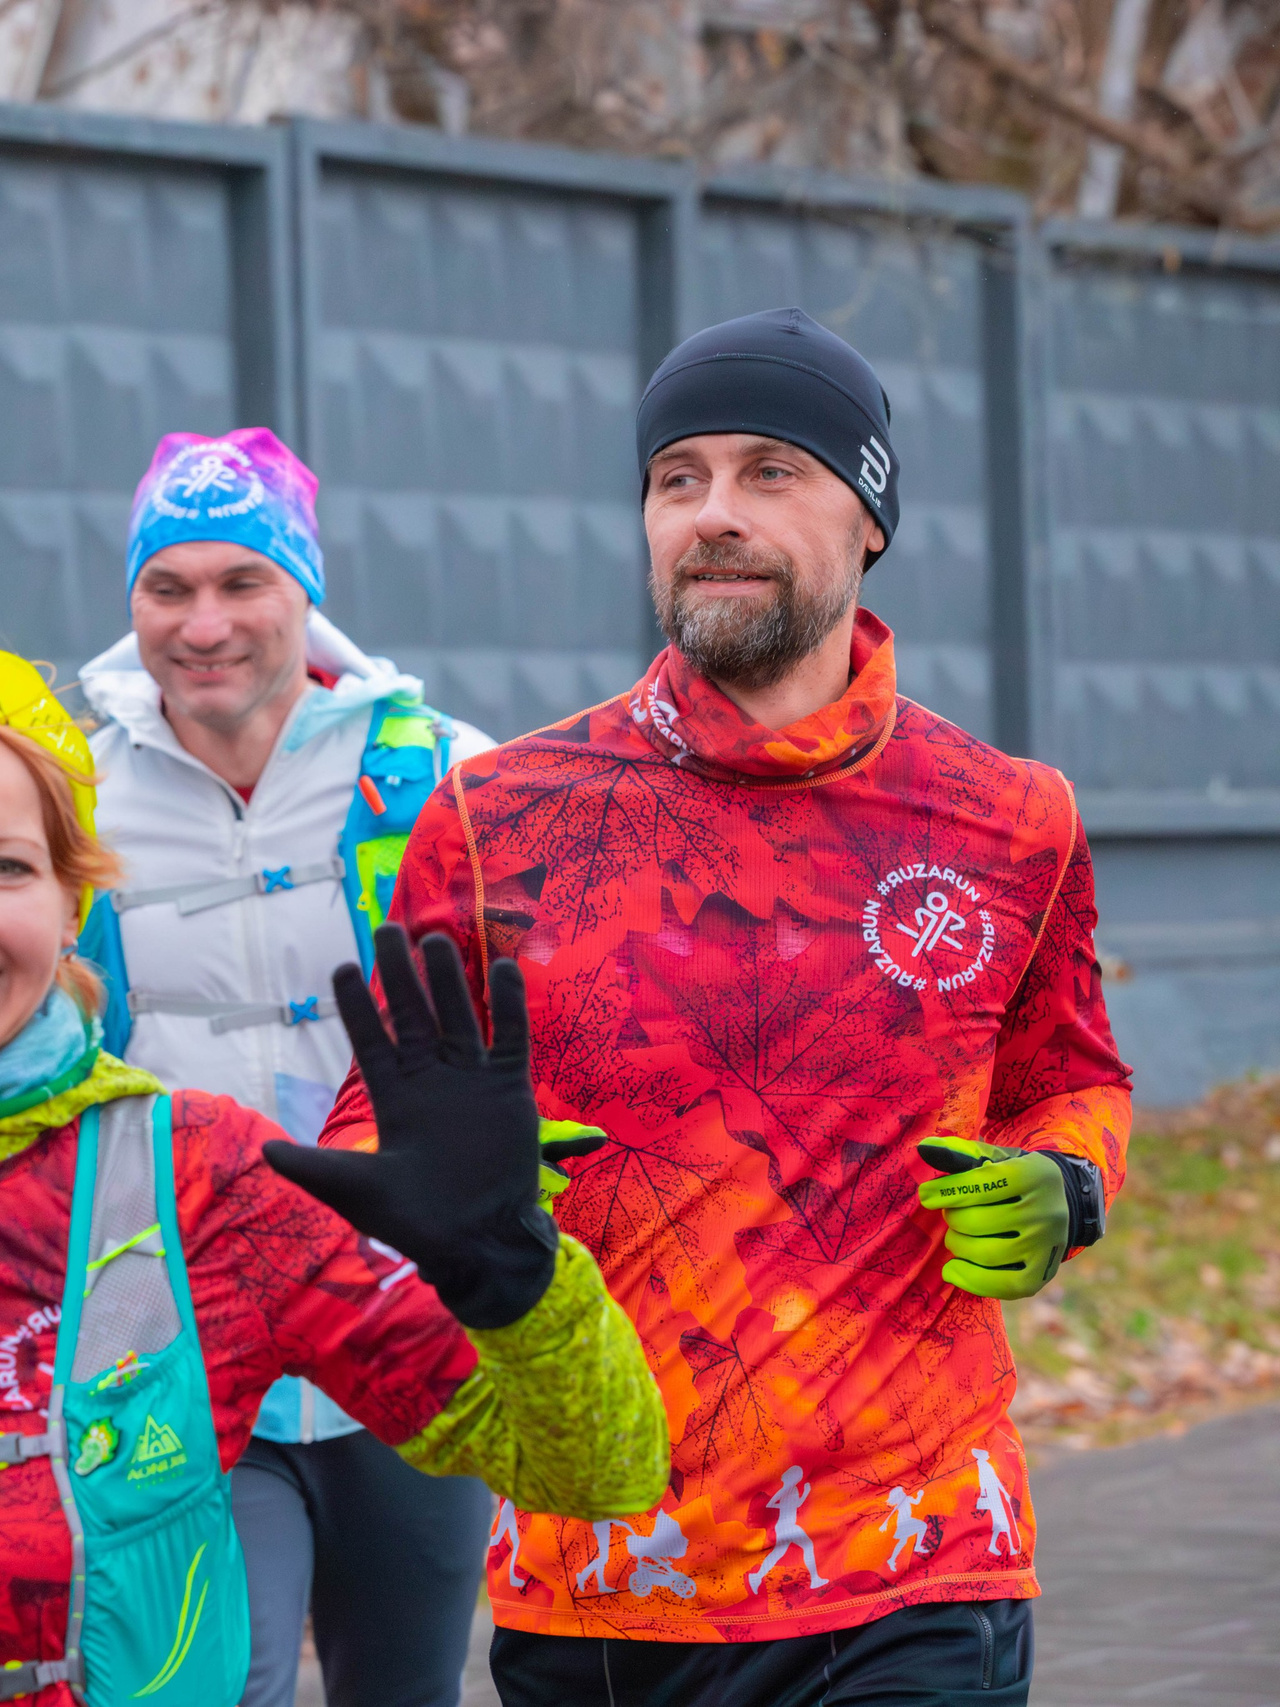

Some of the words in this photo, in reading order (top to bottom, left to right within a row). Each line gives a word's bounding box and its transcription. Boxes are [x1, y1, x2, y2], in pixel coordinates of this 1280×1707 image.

[939, 1187, 956, 1197] RIDE
[956, 1184, 981, 1195] YOUR
[983, 1178, 1008, 1192] RACE
